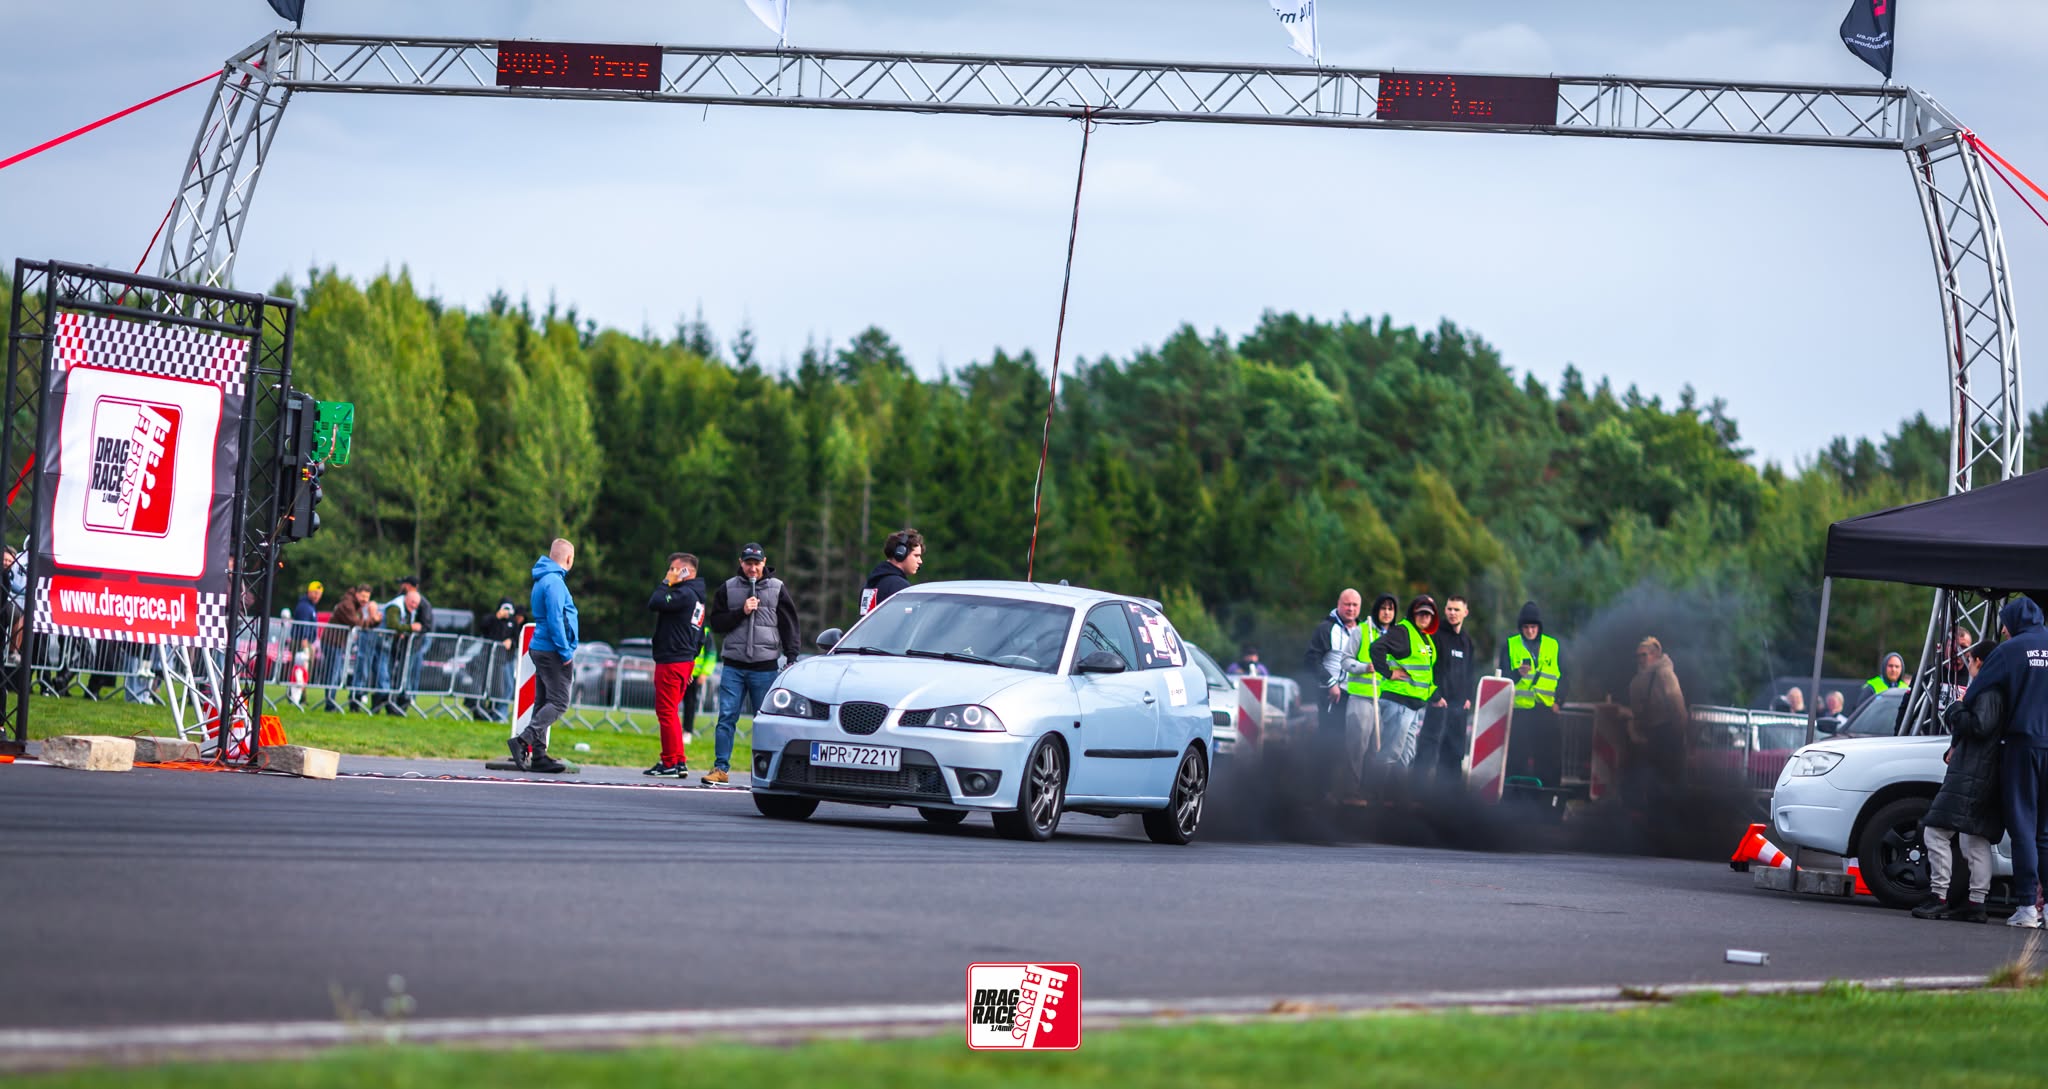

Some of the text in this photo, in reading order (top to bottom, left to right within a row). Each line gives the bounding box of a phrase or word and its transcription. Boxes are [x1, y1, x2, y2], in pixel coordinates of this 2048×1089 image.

[95, 436, 131, 465] DRAG
[91, 462, 125, 493] RACE
[59, 586, 186, 629] www.dragrace.pl
[819, 745, 899, 766] WPR 7221Y
